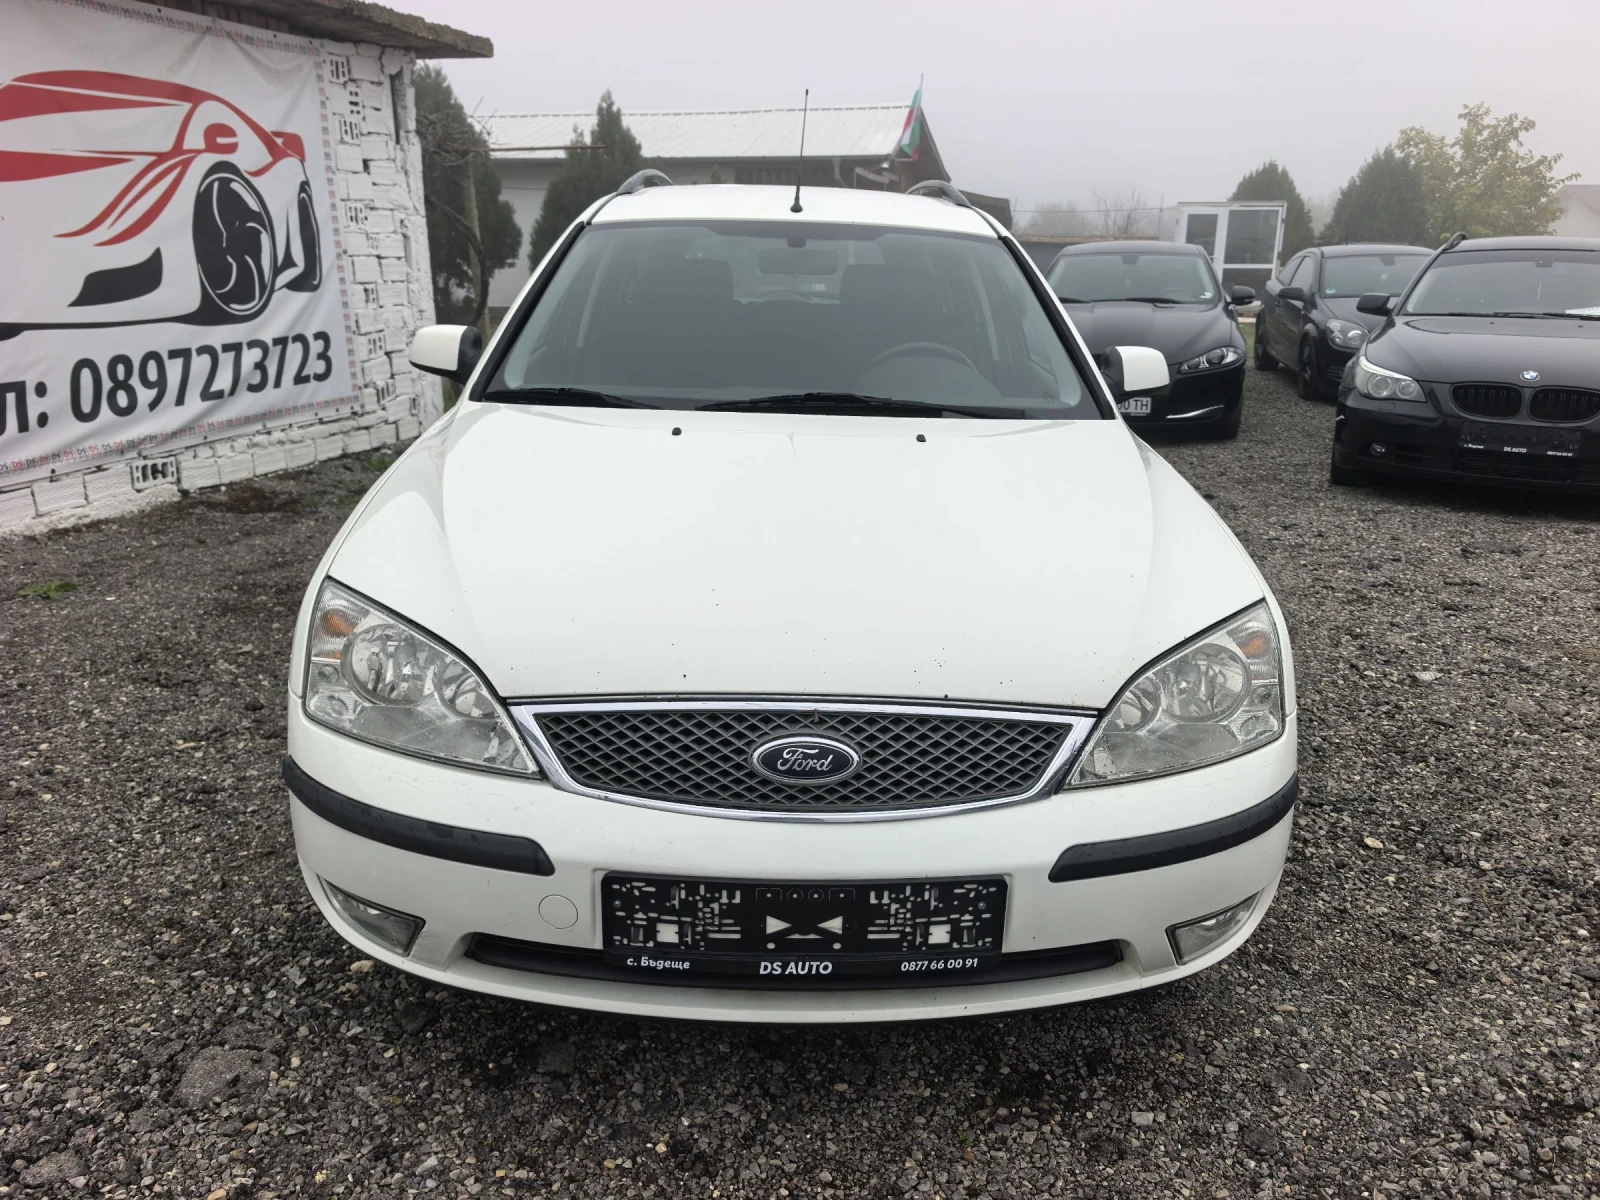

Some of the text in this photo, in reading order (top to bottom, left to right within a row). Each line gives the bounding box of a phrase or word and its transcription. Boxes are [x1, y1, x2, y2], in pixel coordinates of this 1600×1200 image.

[70, 331, 333, 423] 0897273723
[1133, 399, 1149, 411] TH
[89, 445, 99, 453] DS
[777, 748, 834, 771] Ford
[627, 956, 690, 970] с. Бъдеще
[760, 961, 833, 975] DS AUTO
[901, 957, 978, 971] 0877 66 00 91
